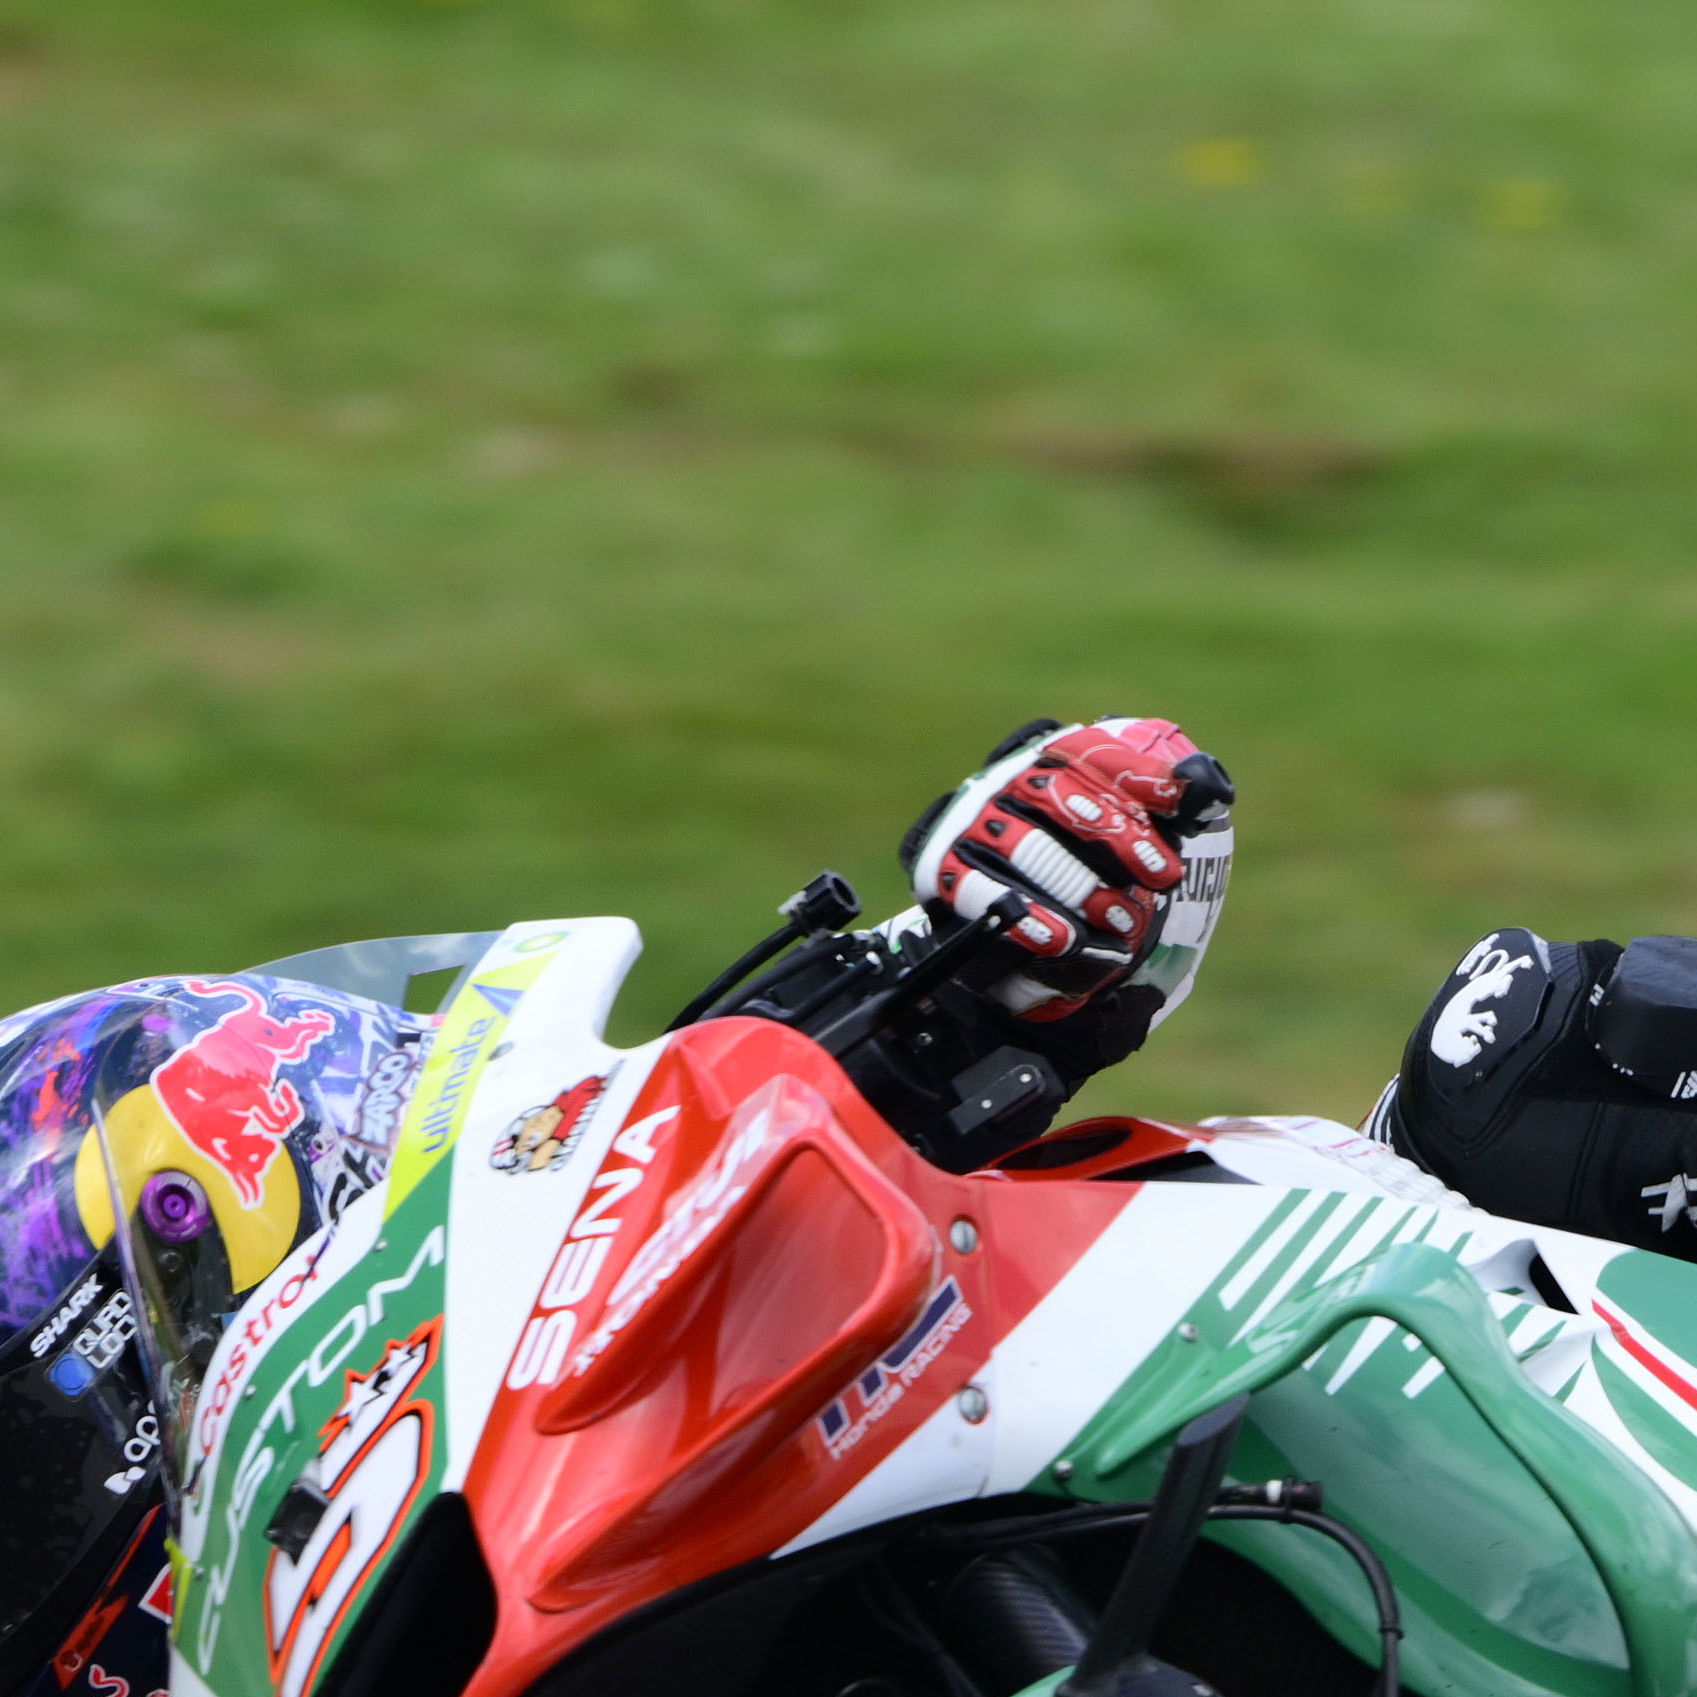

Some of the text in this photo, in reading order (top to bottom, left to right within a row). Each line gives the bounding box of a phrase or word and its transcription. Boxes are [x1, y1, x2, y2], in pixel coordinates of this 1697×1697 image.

[420, 1015, 497, 1153] ultimate
[506, 1103, 684, 1392] SENA
[29, 1272, 104, 1359] SHARK
[72, 1291, 133, 1356] QUAD
[86, 1314, 140, 1370] LOC
[198, 1225, 446, 1676] CUSTOM
